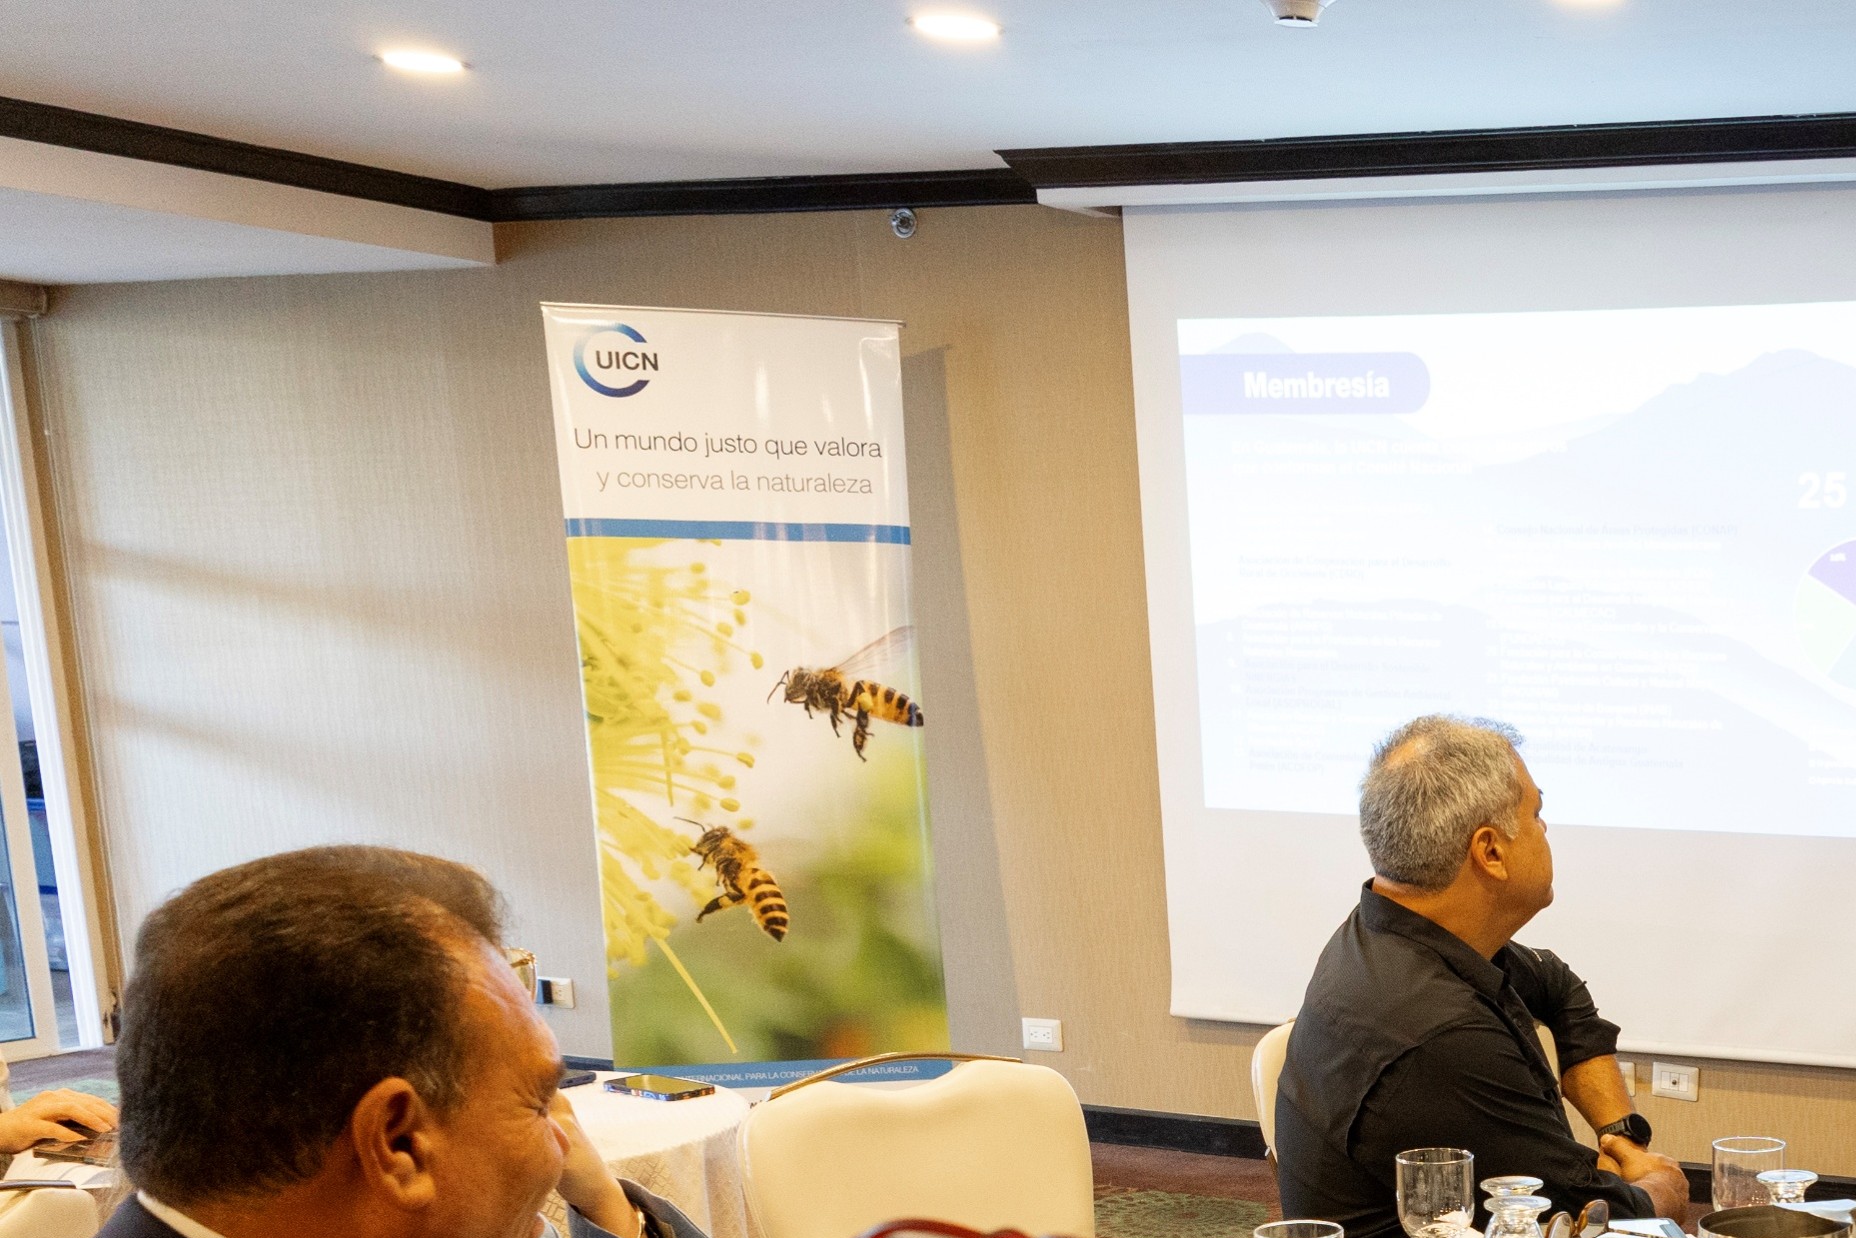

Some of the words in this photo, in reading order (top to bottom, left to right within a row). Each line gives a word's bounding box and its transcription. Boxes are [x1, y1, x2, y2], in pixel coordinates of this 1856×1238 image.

[595, 349, 659, 371] UICN
[1243, 370, 1390, 399] Membresía
[574, 428, 607, 450] Un
[615, 432, 698, 453] mundo
[704, 433, 758, 458] justo
[765, 438, 808, 460] que
[814, 436, 883, 459] valora
[596, 471, 610, 491] y
[617, 470, 724, 491] conserva
[730, 470, 751, 491] la
[757, 472, 874, 494] naturaleza
[1798, 471, 1847, 508] 25
[745, 1072, 767, 1080] PARA
[768, 1071, 780, 1079] LA
[867, 1066, 919, 1075] NATURALEZA
